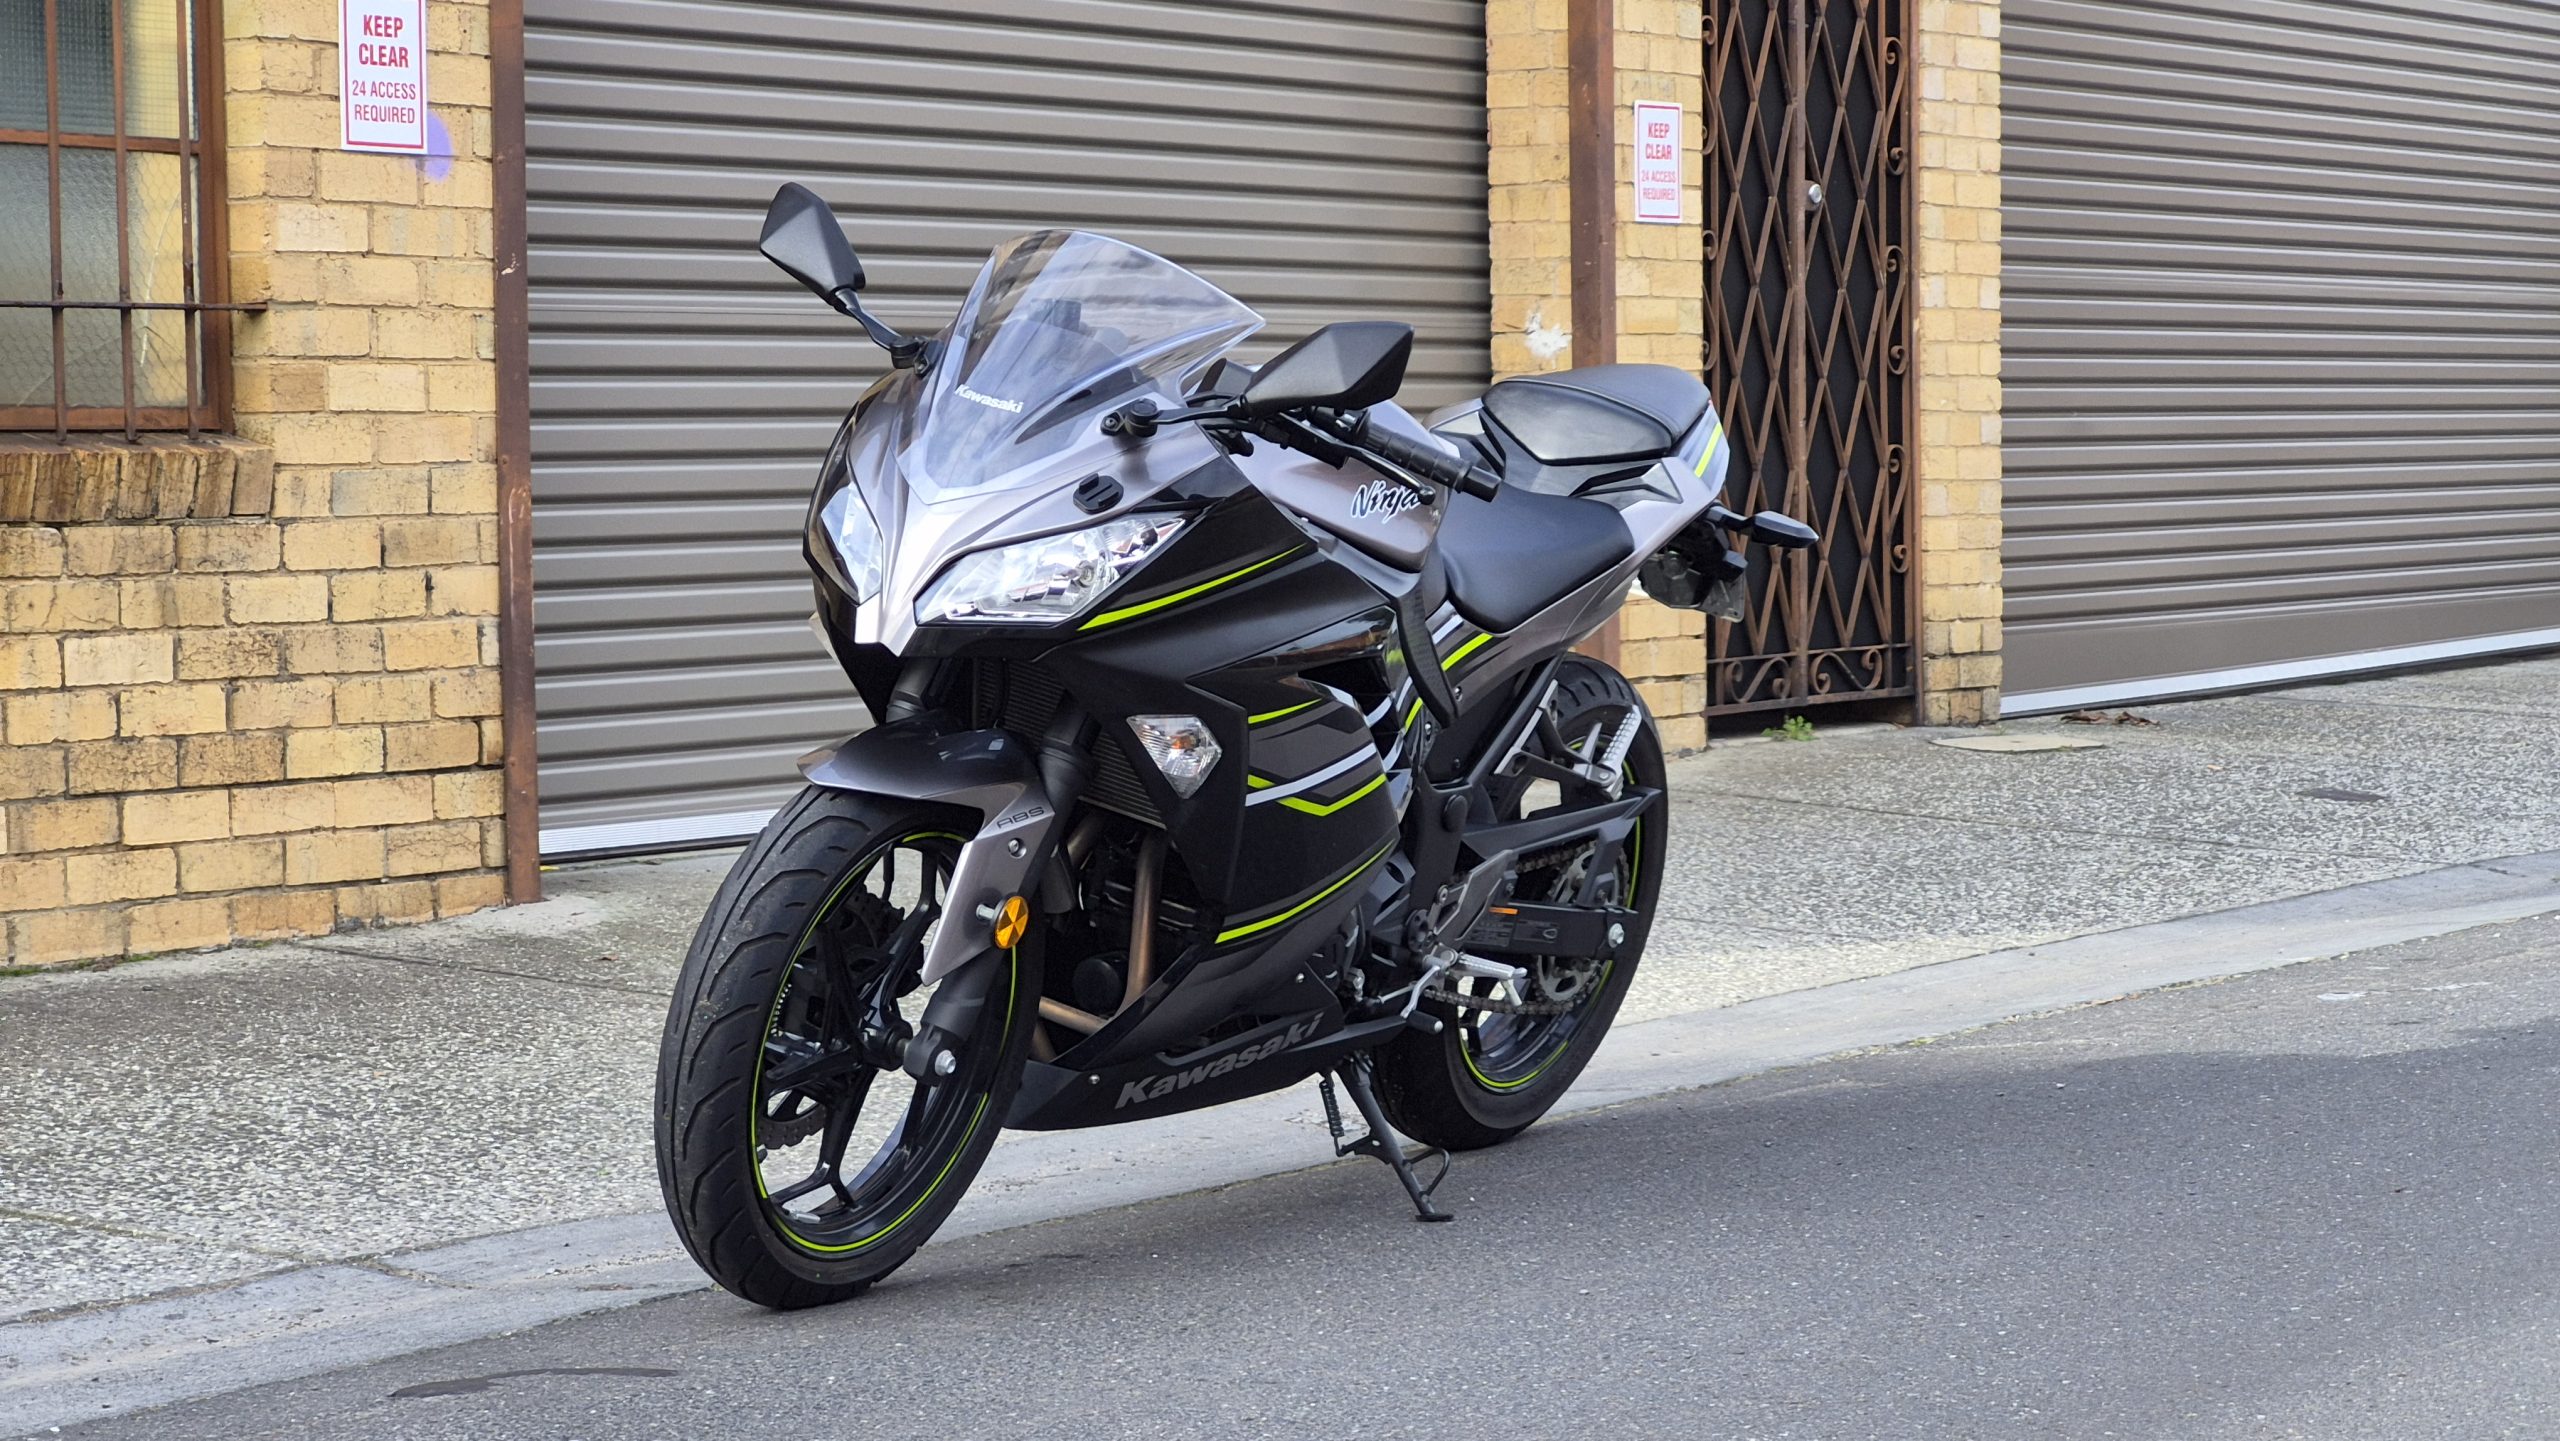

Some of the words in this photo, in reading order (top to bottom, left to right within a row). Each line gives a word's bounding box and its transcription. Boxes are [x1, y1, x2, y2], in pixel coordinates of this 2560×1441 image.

[363, 14, 404, 38] KEEP
[358, 43, 409, 68] CLEAR
[352, 79, 367, 97] 24
[370, 81, 416, 100] ACCESS
[354, 104, 415, 124] REQUIRED
[1647, 122, 1671, 139] KEEP
[1645, 143, 1672, 160] CLEAR
[1641, 170, 1650, 183] 24
[1651, 171, 1676, 183] ACCESS
[1643, 187, 1675, 201] REQUIRED
[954, 383, 1024, 413] Kawasaki
[1351, 480, 1421, 524] Ninja
[996, 806, 1045, 829] ABS
[1114, 1012, 1325, 1110] Kawasaki
